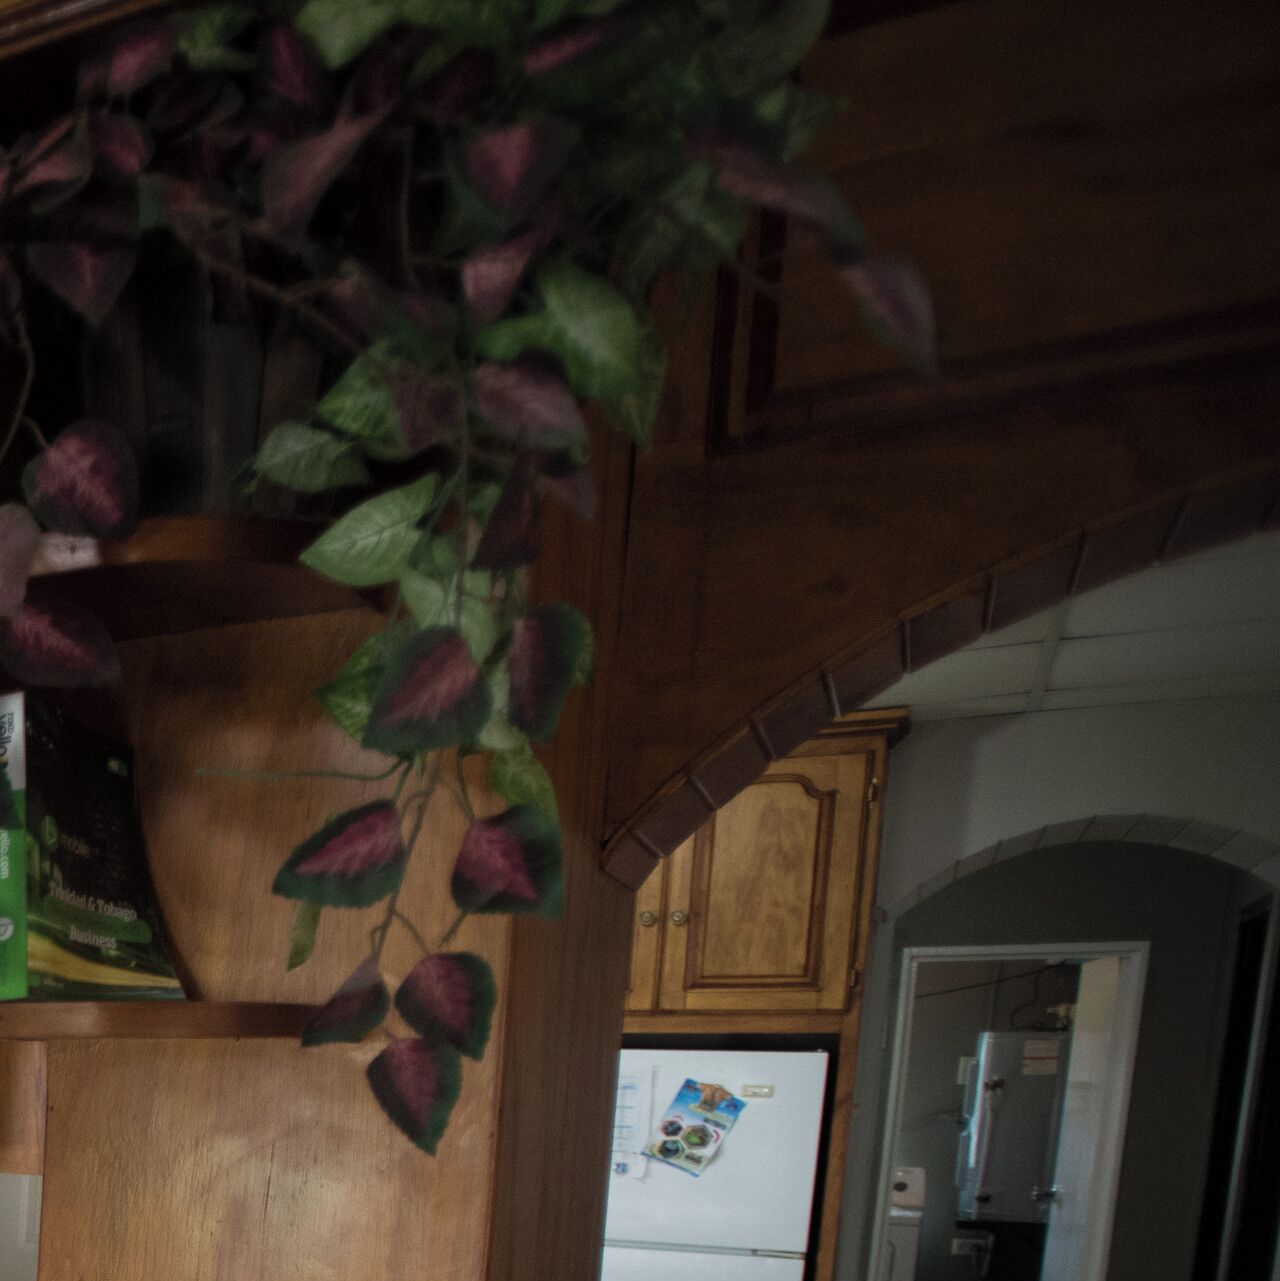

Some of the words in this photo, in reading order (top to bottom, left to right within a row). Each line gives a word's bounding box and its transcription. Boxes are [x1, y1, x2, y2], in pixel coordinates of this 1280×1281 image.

[49, 880, 87, 910] Trinidad
[87, 895, 96, 912] &
[96, 898, 138, 922] Tobago
[69, 925, 117, 949] Business
